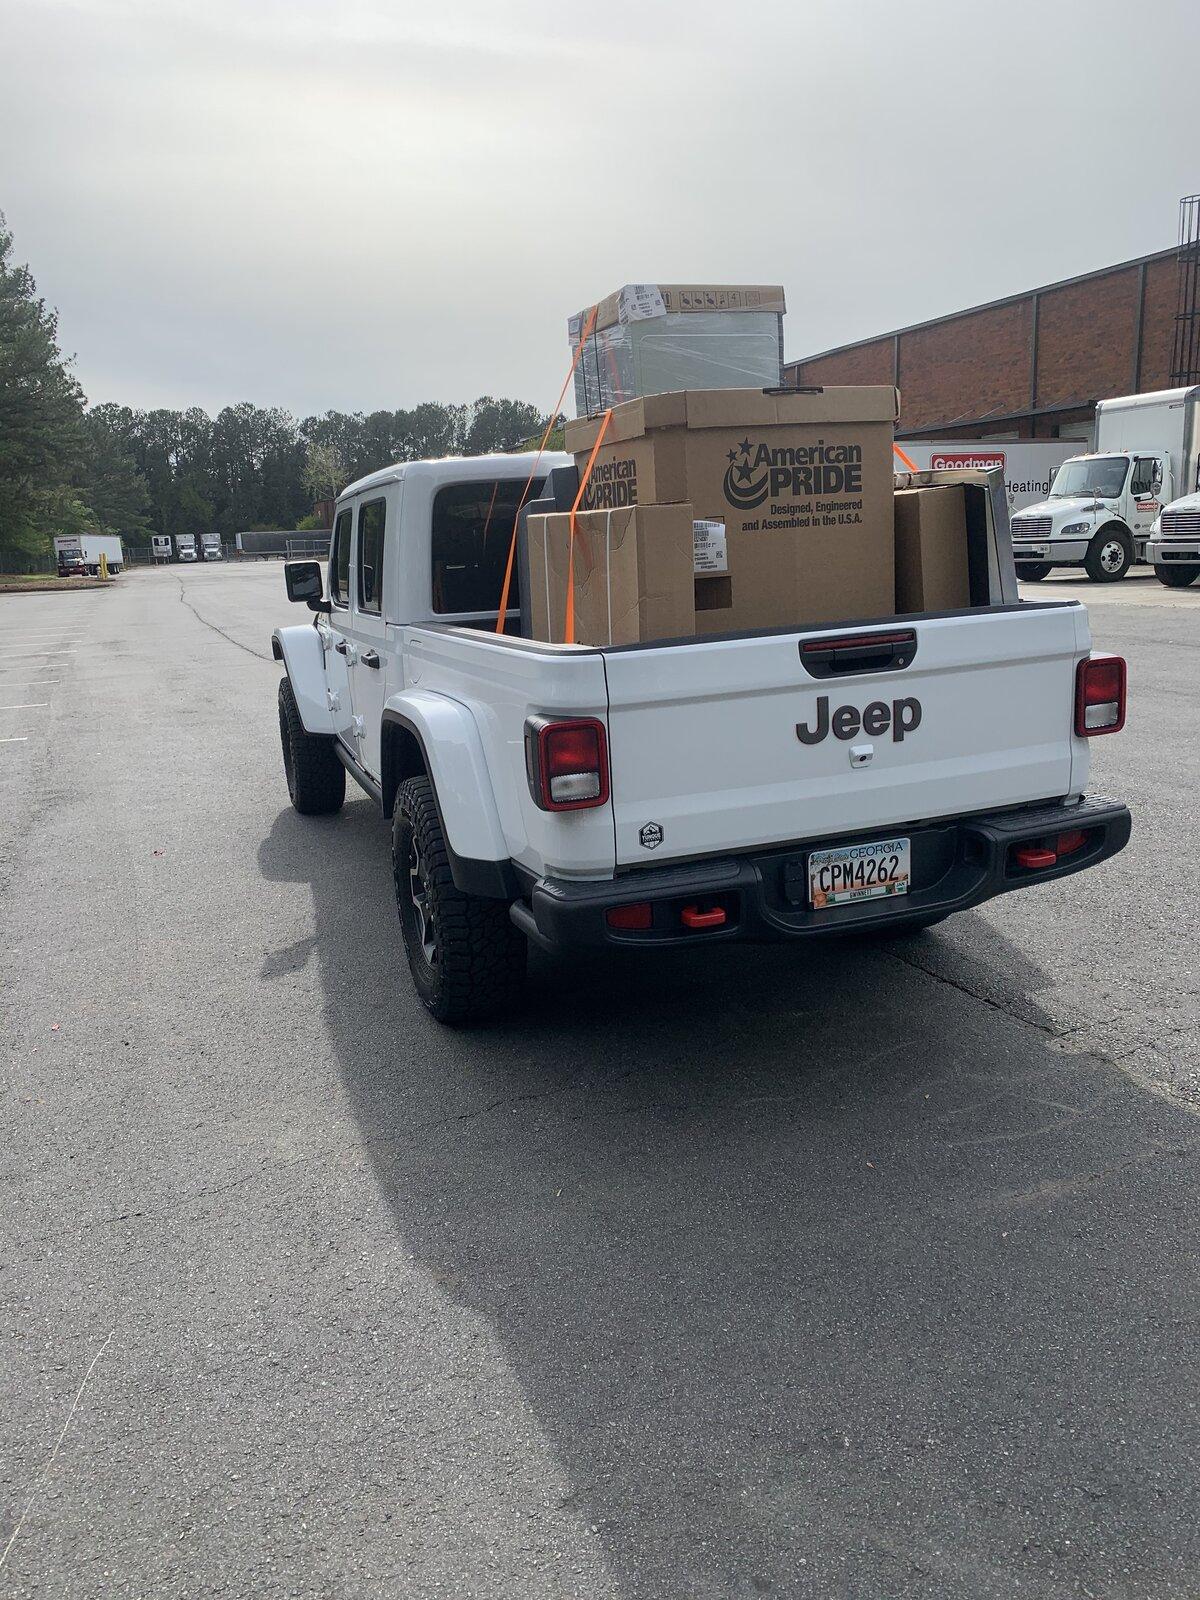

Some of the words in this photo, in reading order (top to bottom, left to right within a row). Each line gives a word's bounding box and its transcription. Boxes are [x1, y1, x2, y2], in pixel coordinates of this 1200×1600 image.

[754, 440, 862, 467] American
[595, 478, 638, 508] PRIDE
[770, 464, 862, 497] PRIDE
[770, 501, 814, 516] Designed,
[816, 499, 862, 514] Engineered
[742, 519, 759, 531] and
[762, 516, 810, 530] Assembled
[812, 515, 820, 527] in
[822, 515, 836, 526] the
[838, 513, 862, 525] U.S.A.
[796, 695, 922, 745] Jeep
[849, 842, 903, 859] GEORGIA
[820, 855, 899, 893] CPM4262
